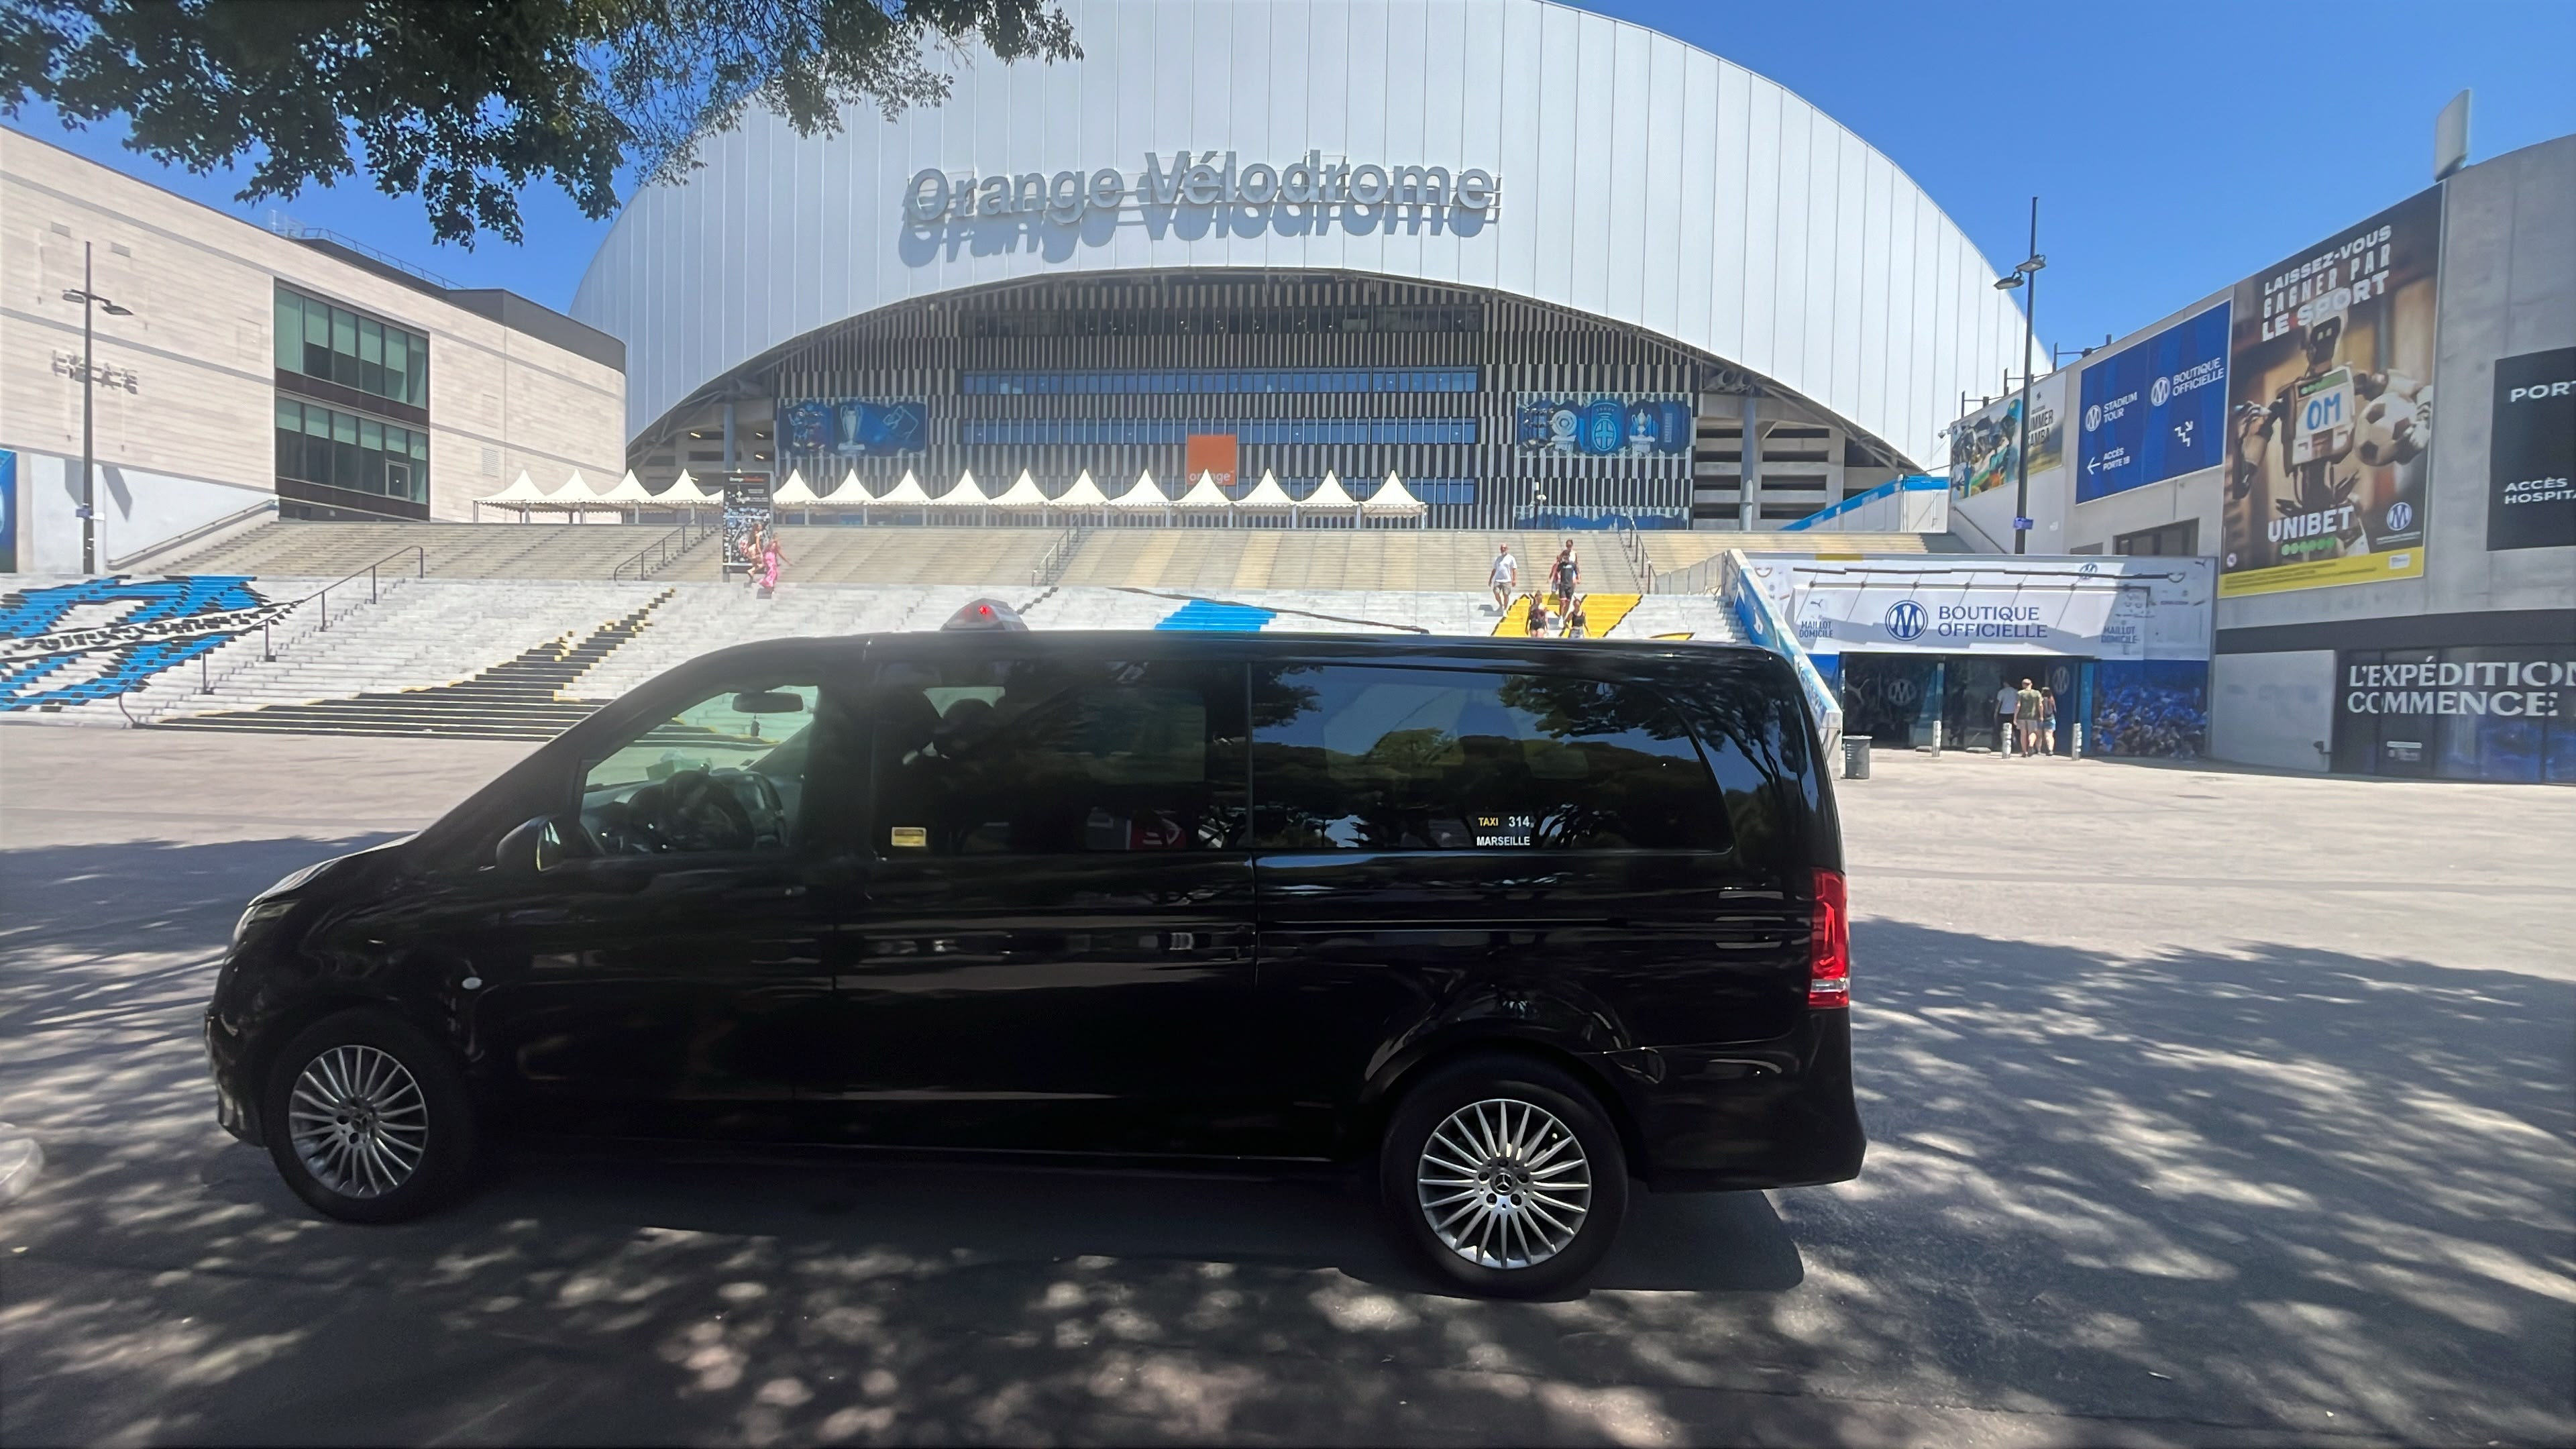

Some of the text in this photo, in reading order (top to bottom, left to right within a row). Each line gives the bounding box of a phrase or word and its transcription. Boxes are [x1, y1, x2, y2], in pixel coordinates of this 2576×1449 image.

[906, 150, 1494, 223] Orange Vélodrome
[2264, 225, 2392, 296] LAISSEZ-VOUS
[2263, 243, 2391, 319] GAGNER PAR
[2262, 270, 2390, 342] LE SPORT
[2174, 357, 2221, 385] BOUTIQUE
[2172, 368, 2224, 396] OFFICIELLE
[2510, 380, 2576, 402] POR
[2103, 391, 2138, 413] STADIUM
[2306, 392, 2341, 430] OM
[2103, 407, 2125, 423] TOUR
[2103, 447, 2125, 461] ACCÈS
[2103, 458, 2123, 471] PORTE
[2505, 477, 2568, 492] ACCÈS
[2268, 504, 2355, 543] UNIBET
[1939, 606, 2040, 623] BOUTIQUE
[1799, 629, 1833, 638] DOMICILE
[1801, 621, 1832, 629] MAILLOT
[1937, 623, 2048, 638] OFFICIELLE
[2103, 625, 2136, 635] MAILLOT
[2347, 690, 2559, 716] COMMENCE
[1478, 816, 1530, 827] TAXI 314
[1477, 836, 1531, 847] MARSEILLE
